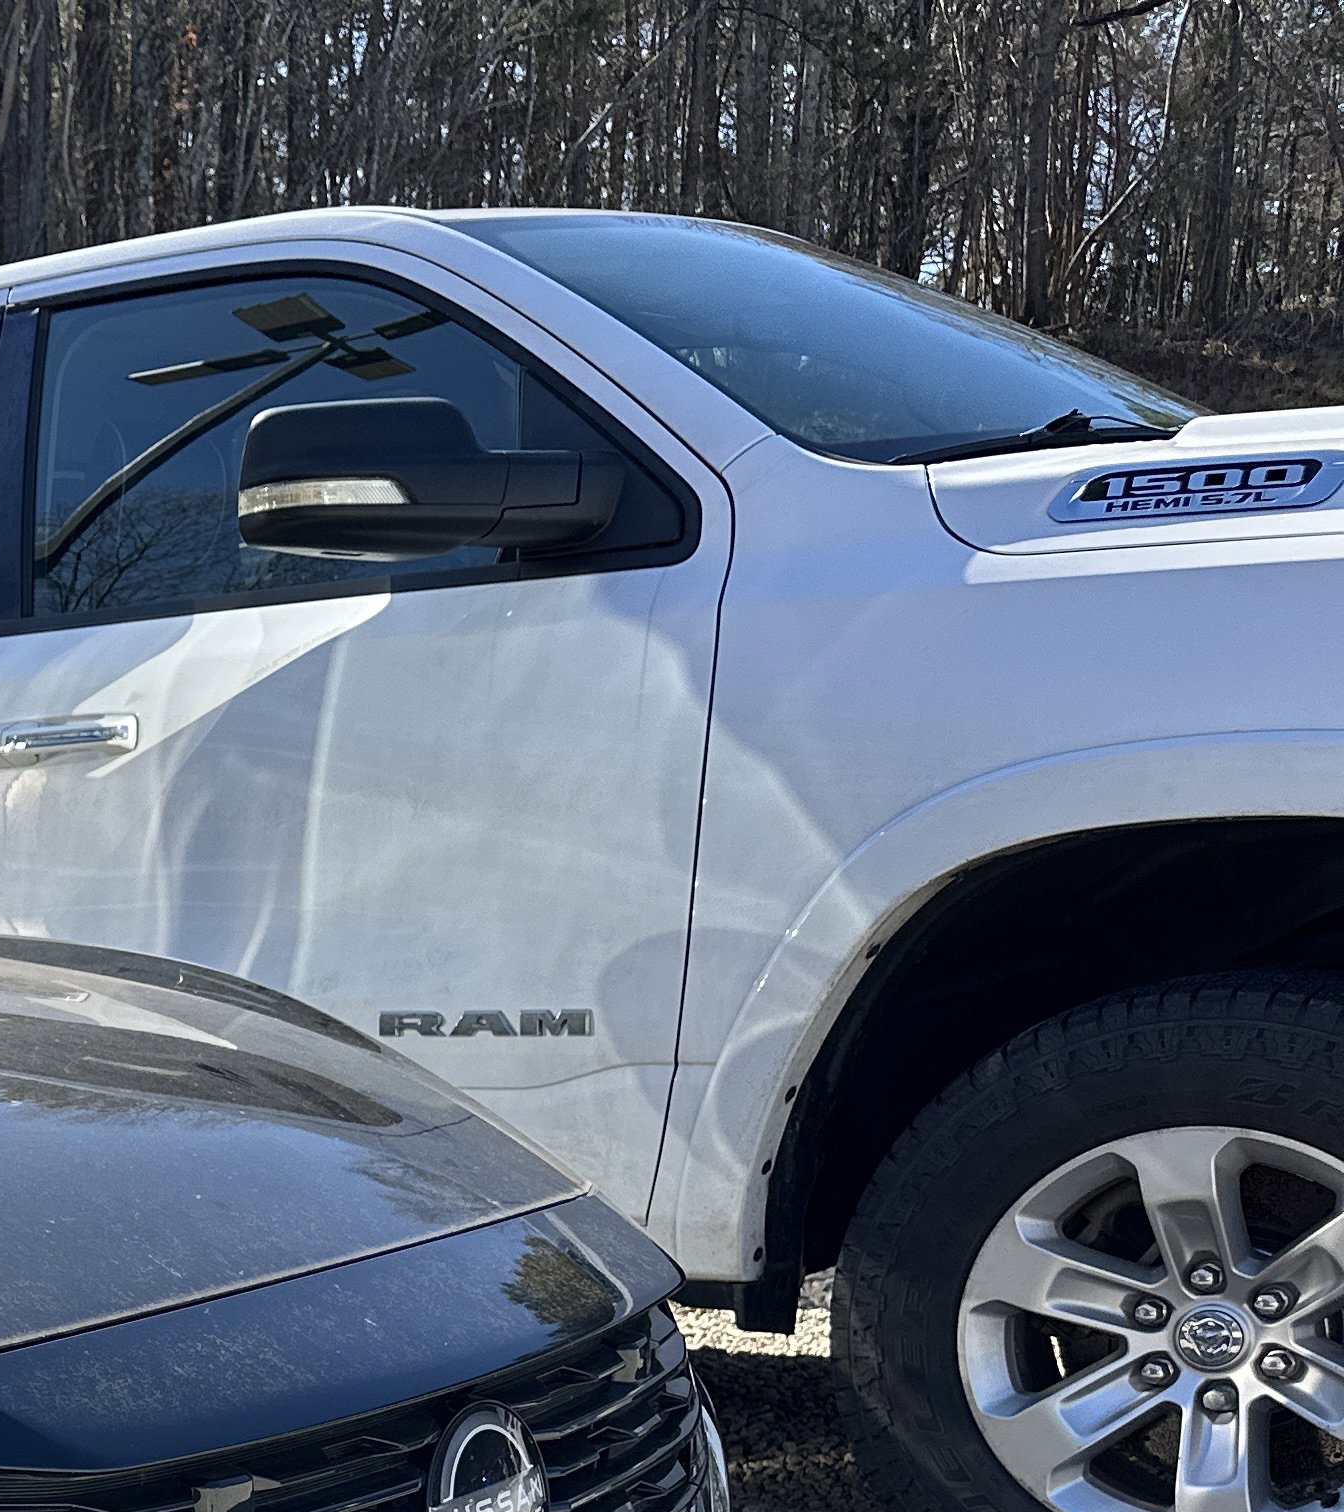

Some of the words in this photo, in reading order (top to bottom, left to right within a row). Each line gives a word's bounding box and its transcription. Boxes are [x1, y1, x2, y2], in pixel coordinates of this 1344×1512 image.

[1102, 464, 1304, 497] 1500
[1105, 498, 1191, 513] HEMI
[1200, 490, 1276, 507] 5.7L
[379, 1008, 595, 1037] RAM
